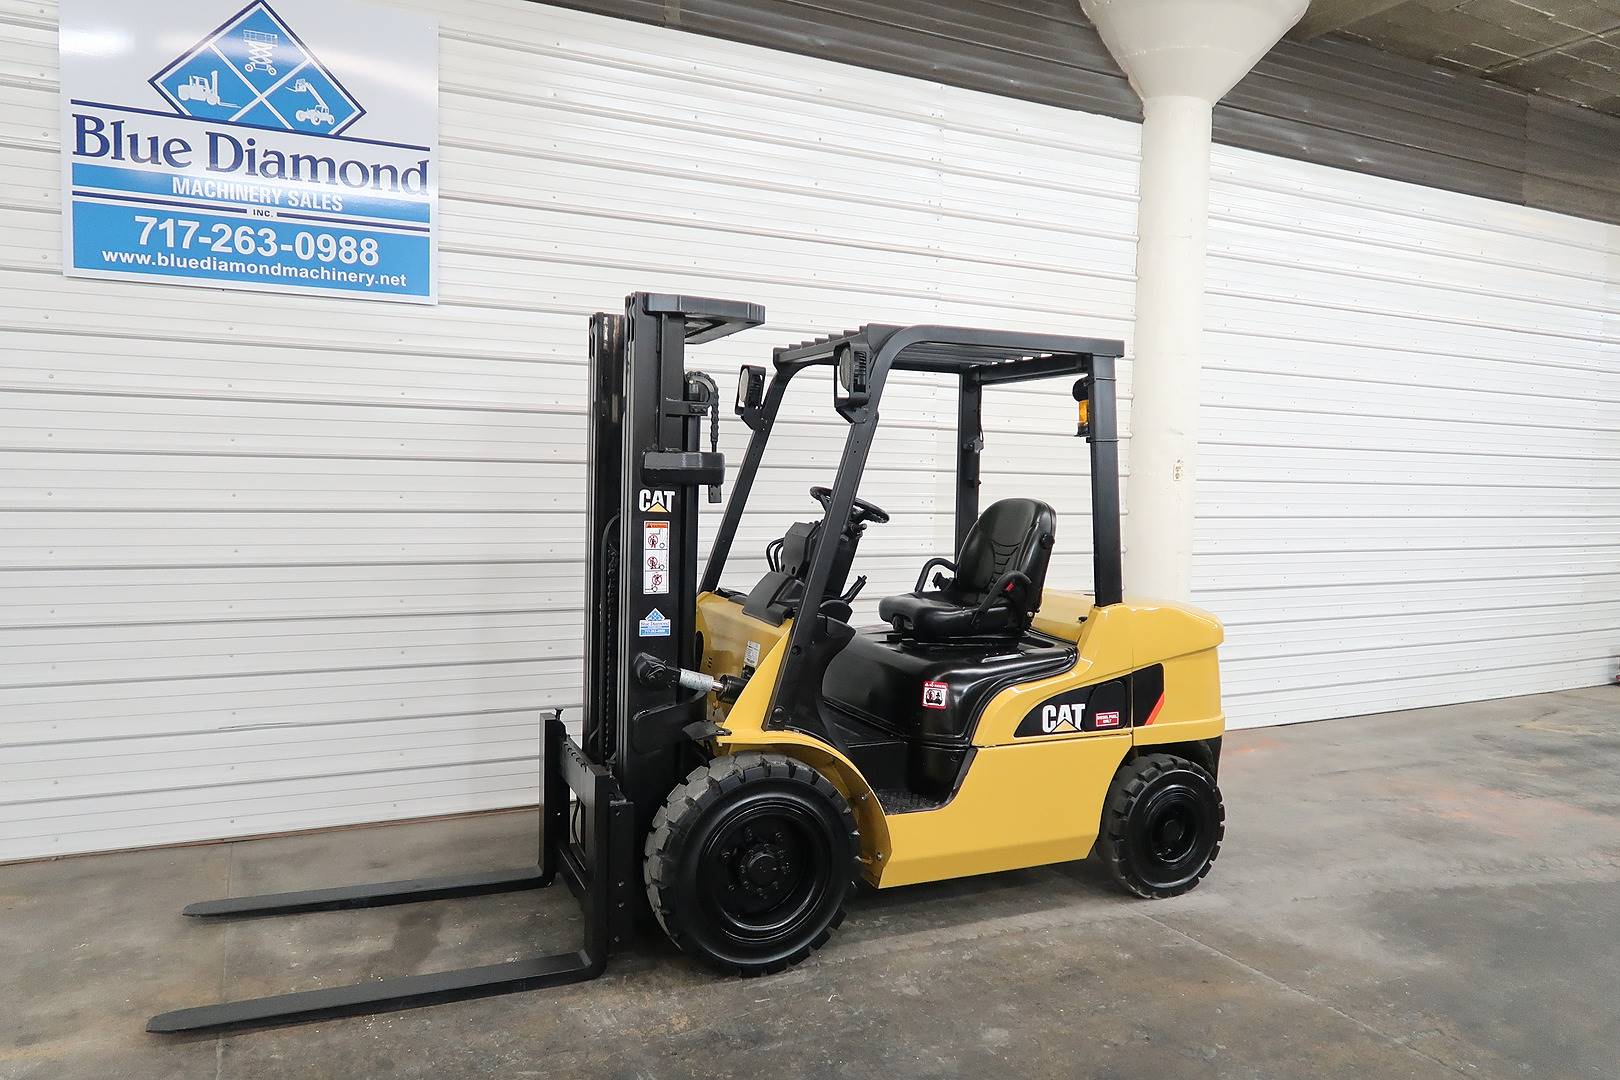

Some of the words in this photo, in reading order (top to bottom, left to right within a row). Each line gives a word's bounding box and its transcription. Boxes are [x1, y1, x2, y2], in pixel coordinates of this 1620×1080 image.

[72, 113, 192, 167] Blue
[205, 132, 430, 195] Diamond
[172, 176, 281, 206] MACHINERY
[288, 191, 343, 211] SALES
[252, 208, 274, 218] INC.
[134, 215, 379, 266] 717-263-0988
[102, 250, 407, 287] www.bluediamondmachinery.net
[639, 489, 676, 513] CAT
[1042, 703, 1086, 733] CAT
